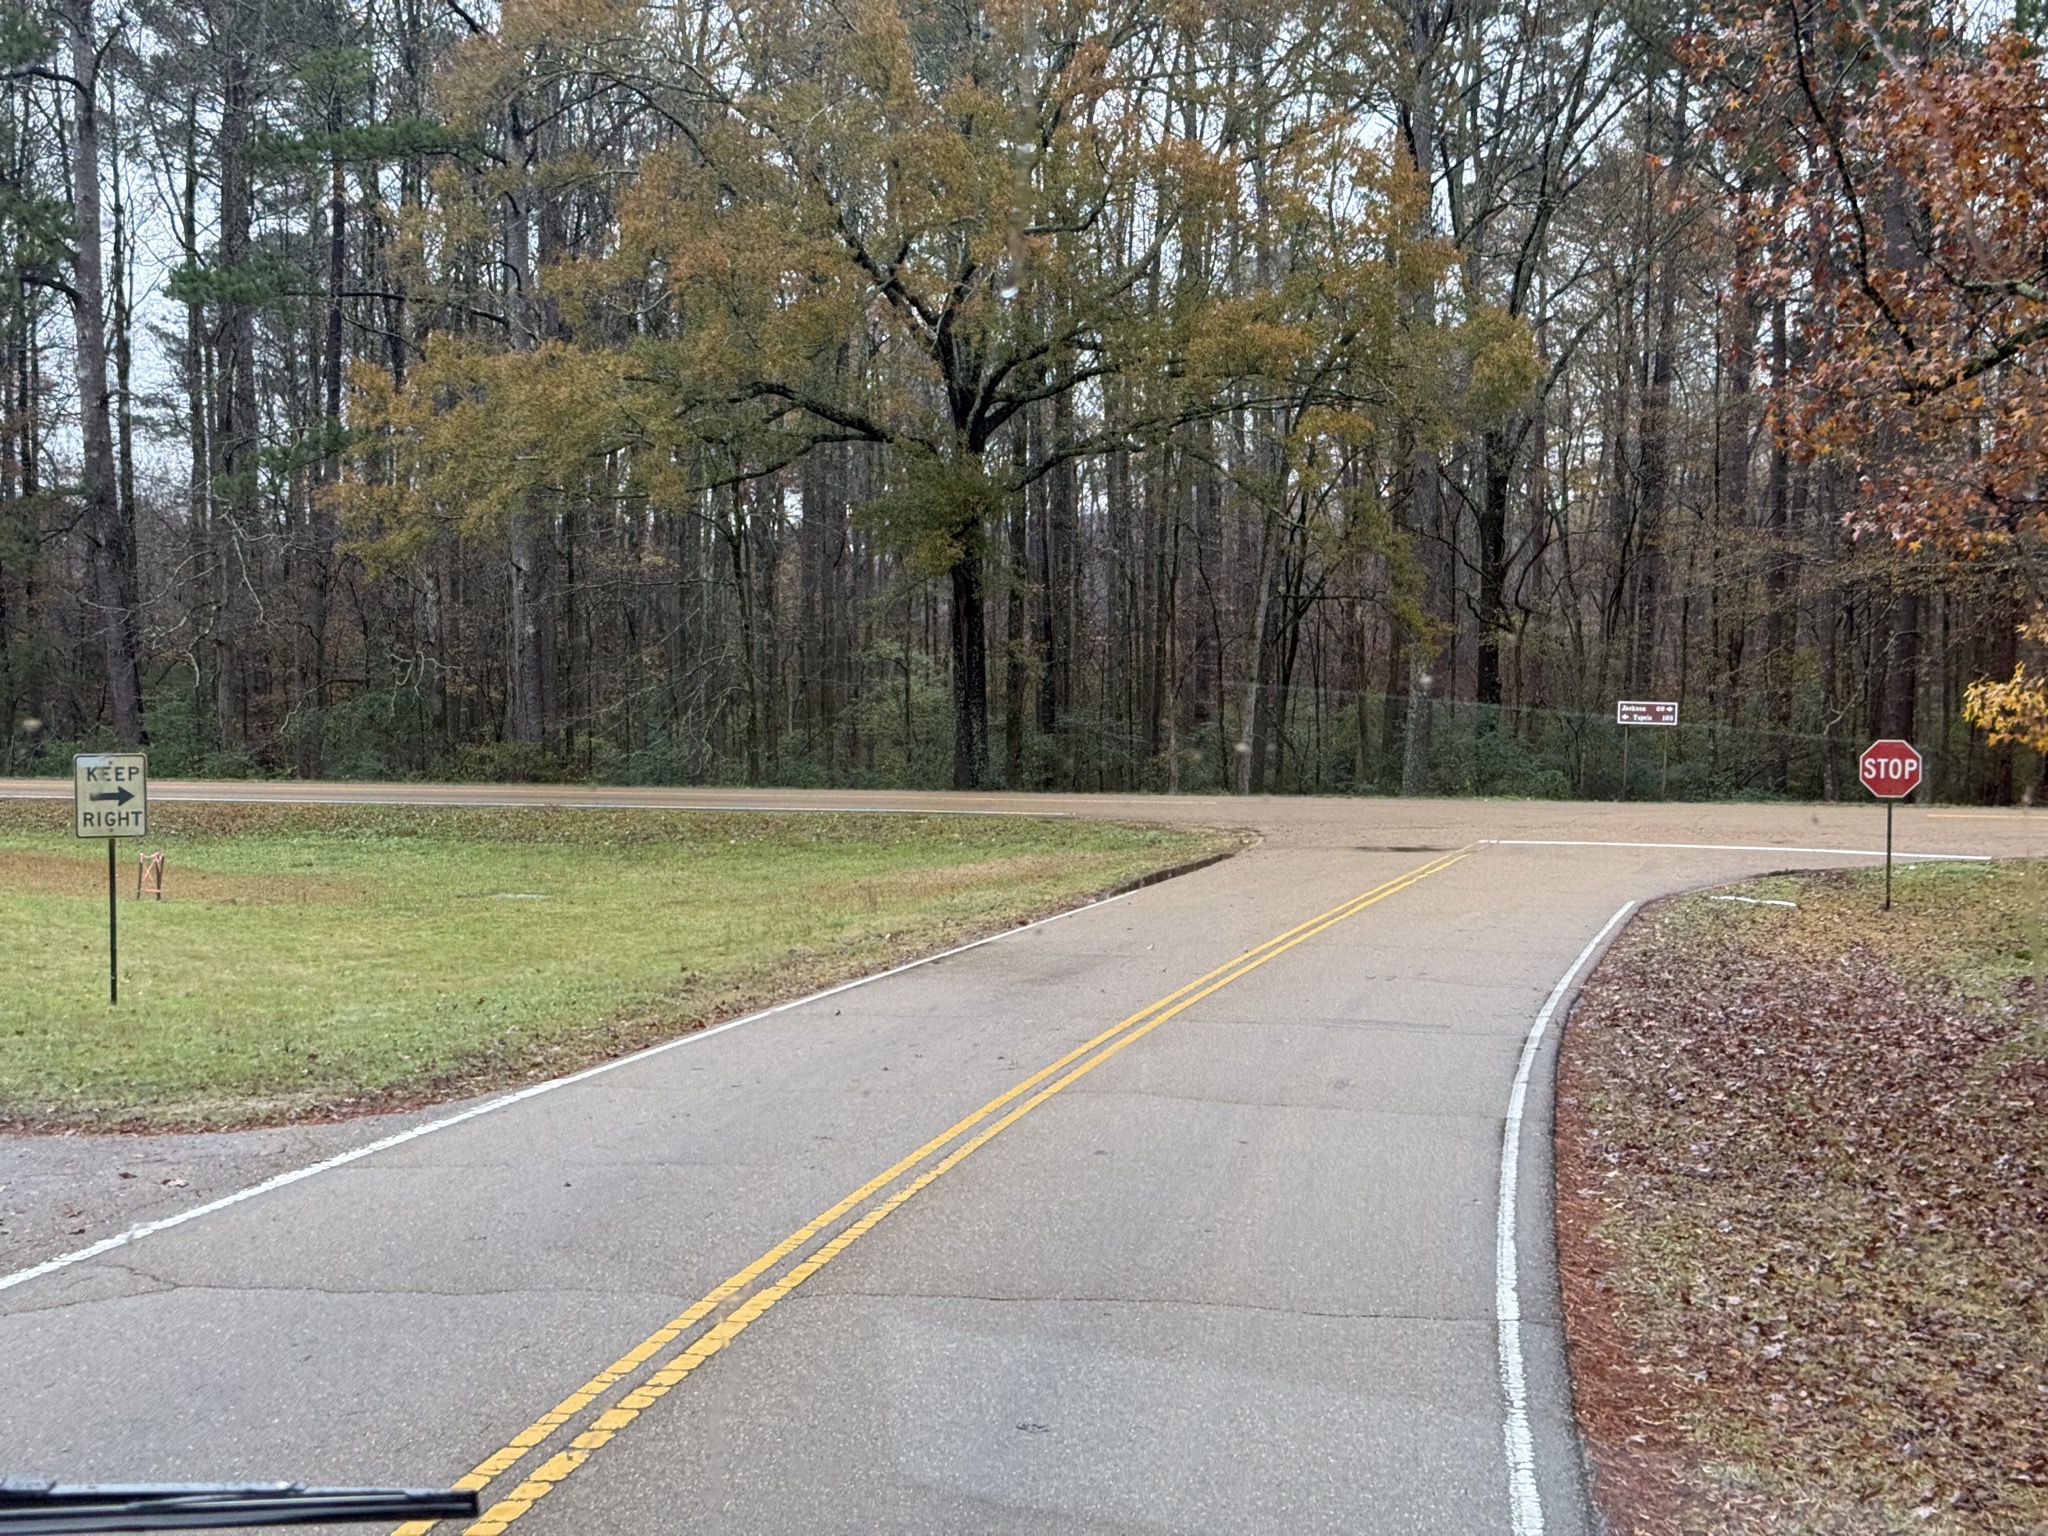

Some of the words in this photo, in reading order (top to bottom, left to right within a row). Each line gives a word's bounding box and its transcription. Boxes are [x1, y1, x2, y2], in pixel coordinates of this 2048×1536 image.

[87, 766, 140, 782] KEEP
[1863, 757, 1918, 780] STOP
[83, 811, 143, 827] RIGHT
